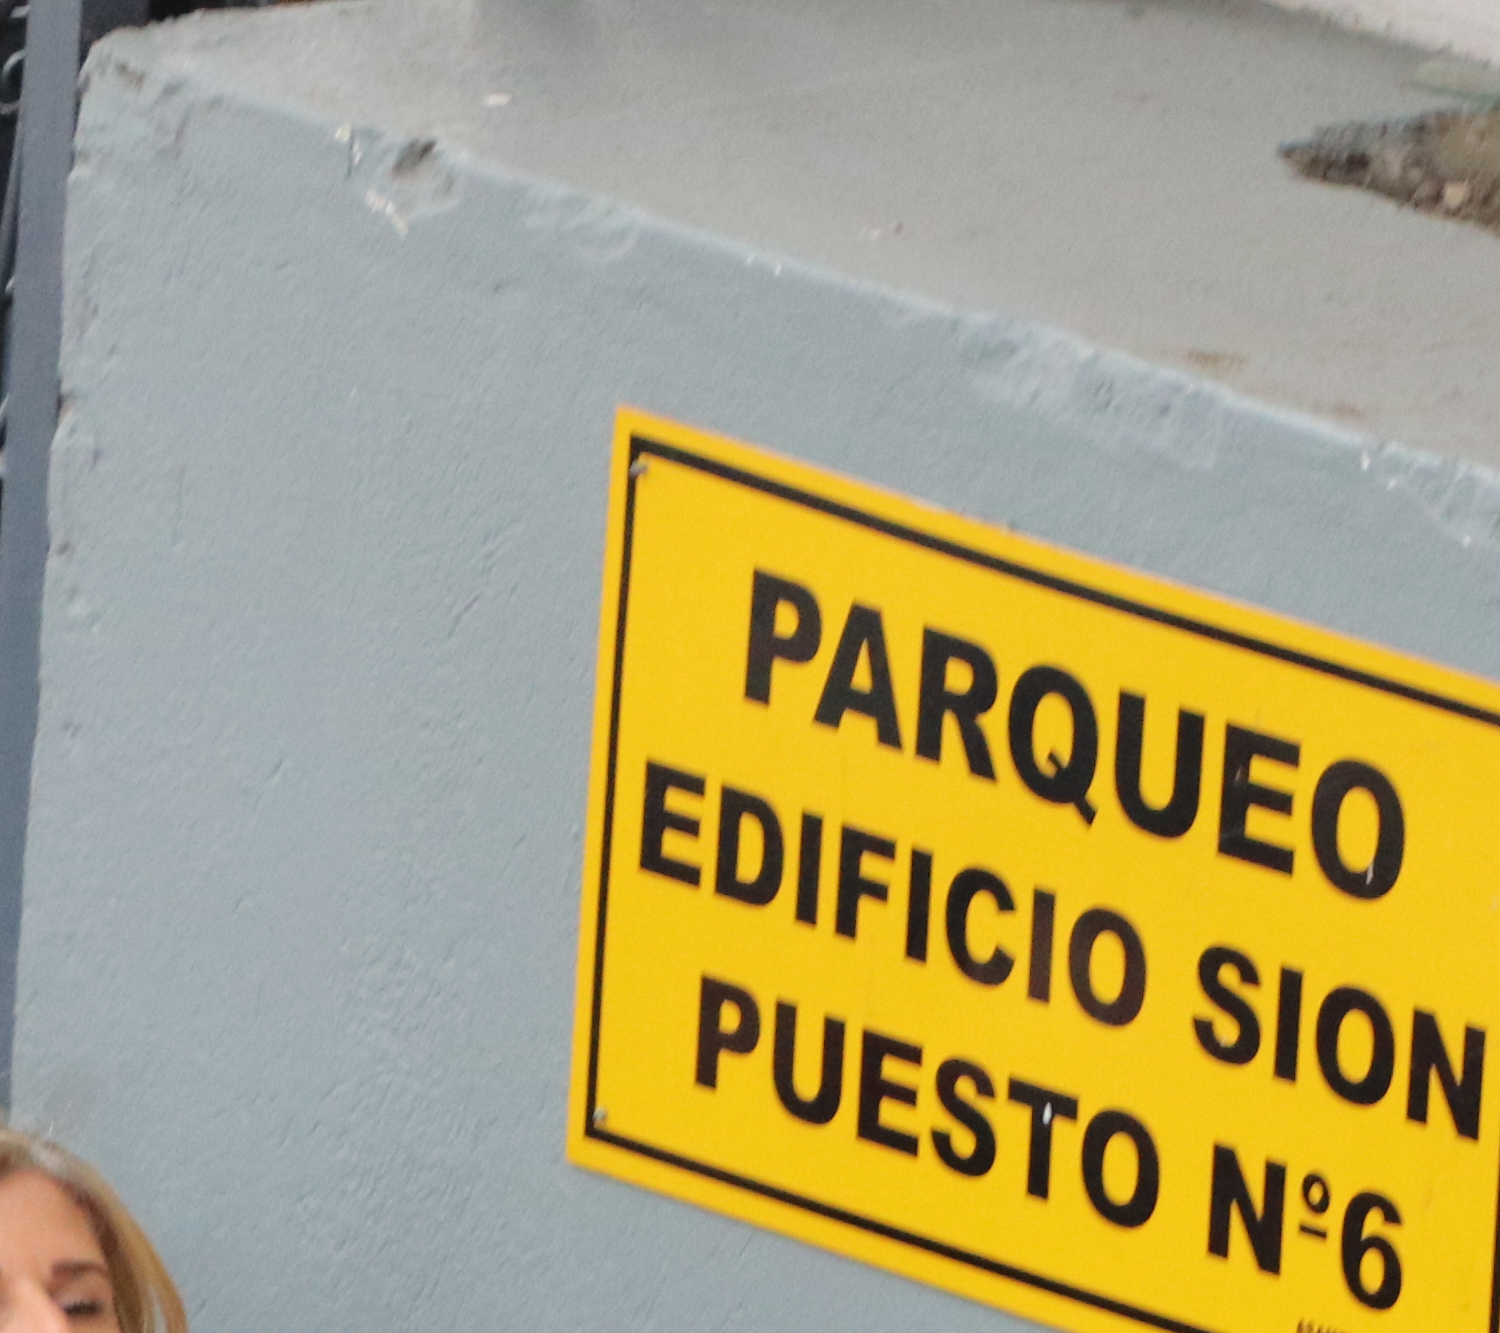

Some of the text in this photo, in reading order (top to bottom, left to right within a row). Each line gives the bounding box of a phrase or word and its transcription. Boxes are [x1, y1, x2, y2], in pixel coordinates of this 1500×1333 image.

[743, 569, 1406, 901] PARQUEO
[638, 760, 1487, 1142] EDIFICIO SION
[694, 975, 1161, 1230] PUESTO
